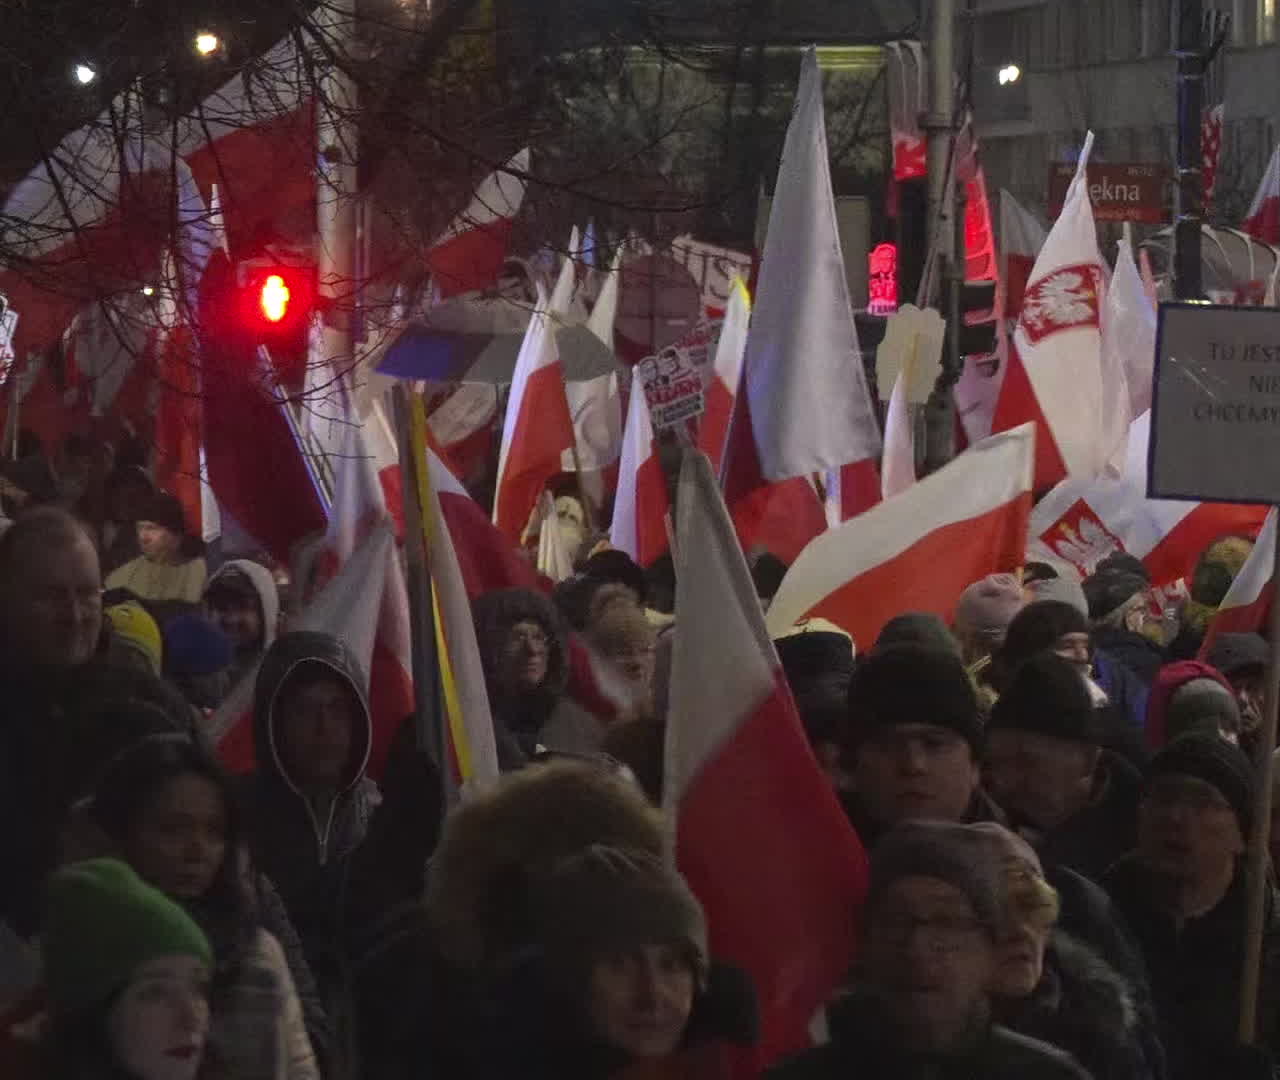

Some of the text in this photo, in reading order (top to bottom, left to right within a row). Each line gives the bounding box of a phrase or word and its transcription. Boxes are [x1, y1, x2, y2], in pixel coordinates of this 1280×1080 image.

[1088, 176, 1140, 208] ękna
[1249, 375, 1280, 394] NIE
[1193, 403, 1280, 424] CHCEMY
